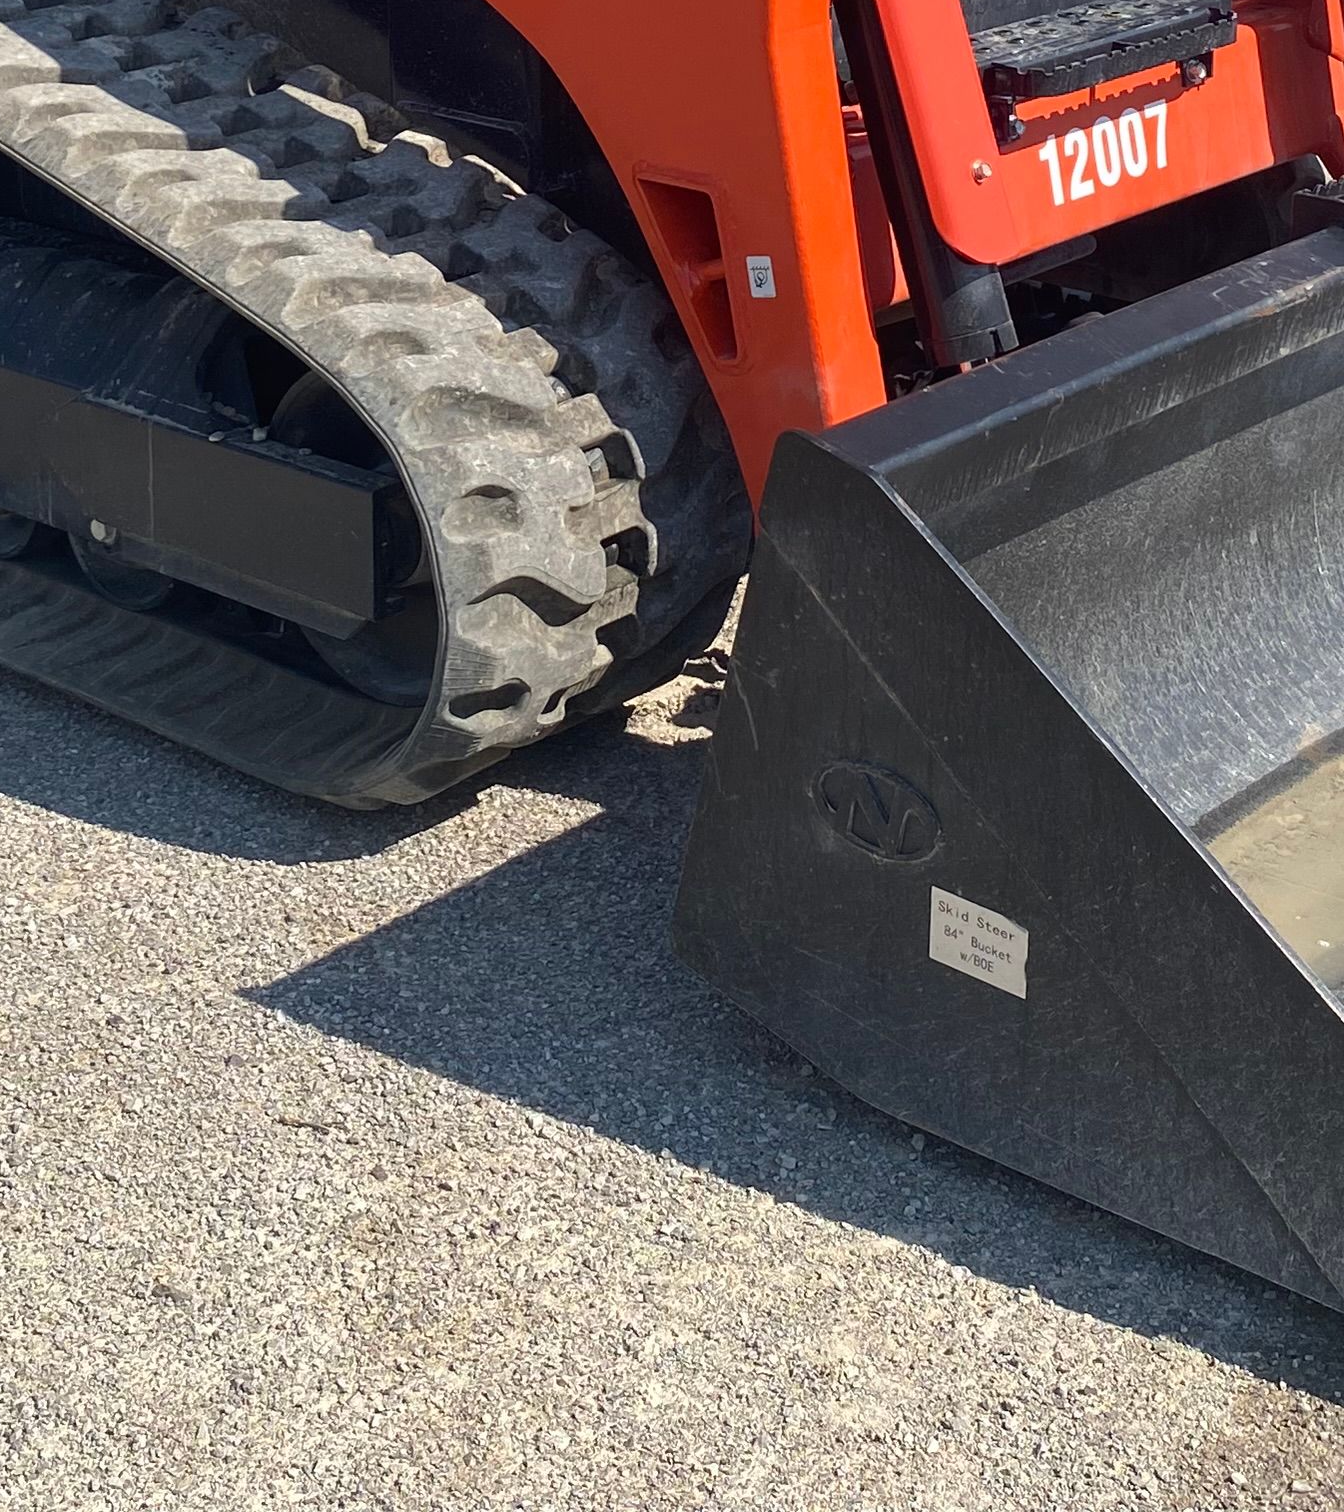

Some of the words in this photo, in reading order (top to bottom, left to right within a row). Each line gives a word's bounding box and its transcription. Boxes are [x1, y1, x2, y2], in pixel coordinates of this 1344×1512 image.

[1038, 99, 1168, 206] 12007
[938, 900, 969, 923] Skid
[976, 916, 1015, 941] Steer
[971, 936, 1012, 964] Bucket
